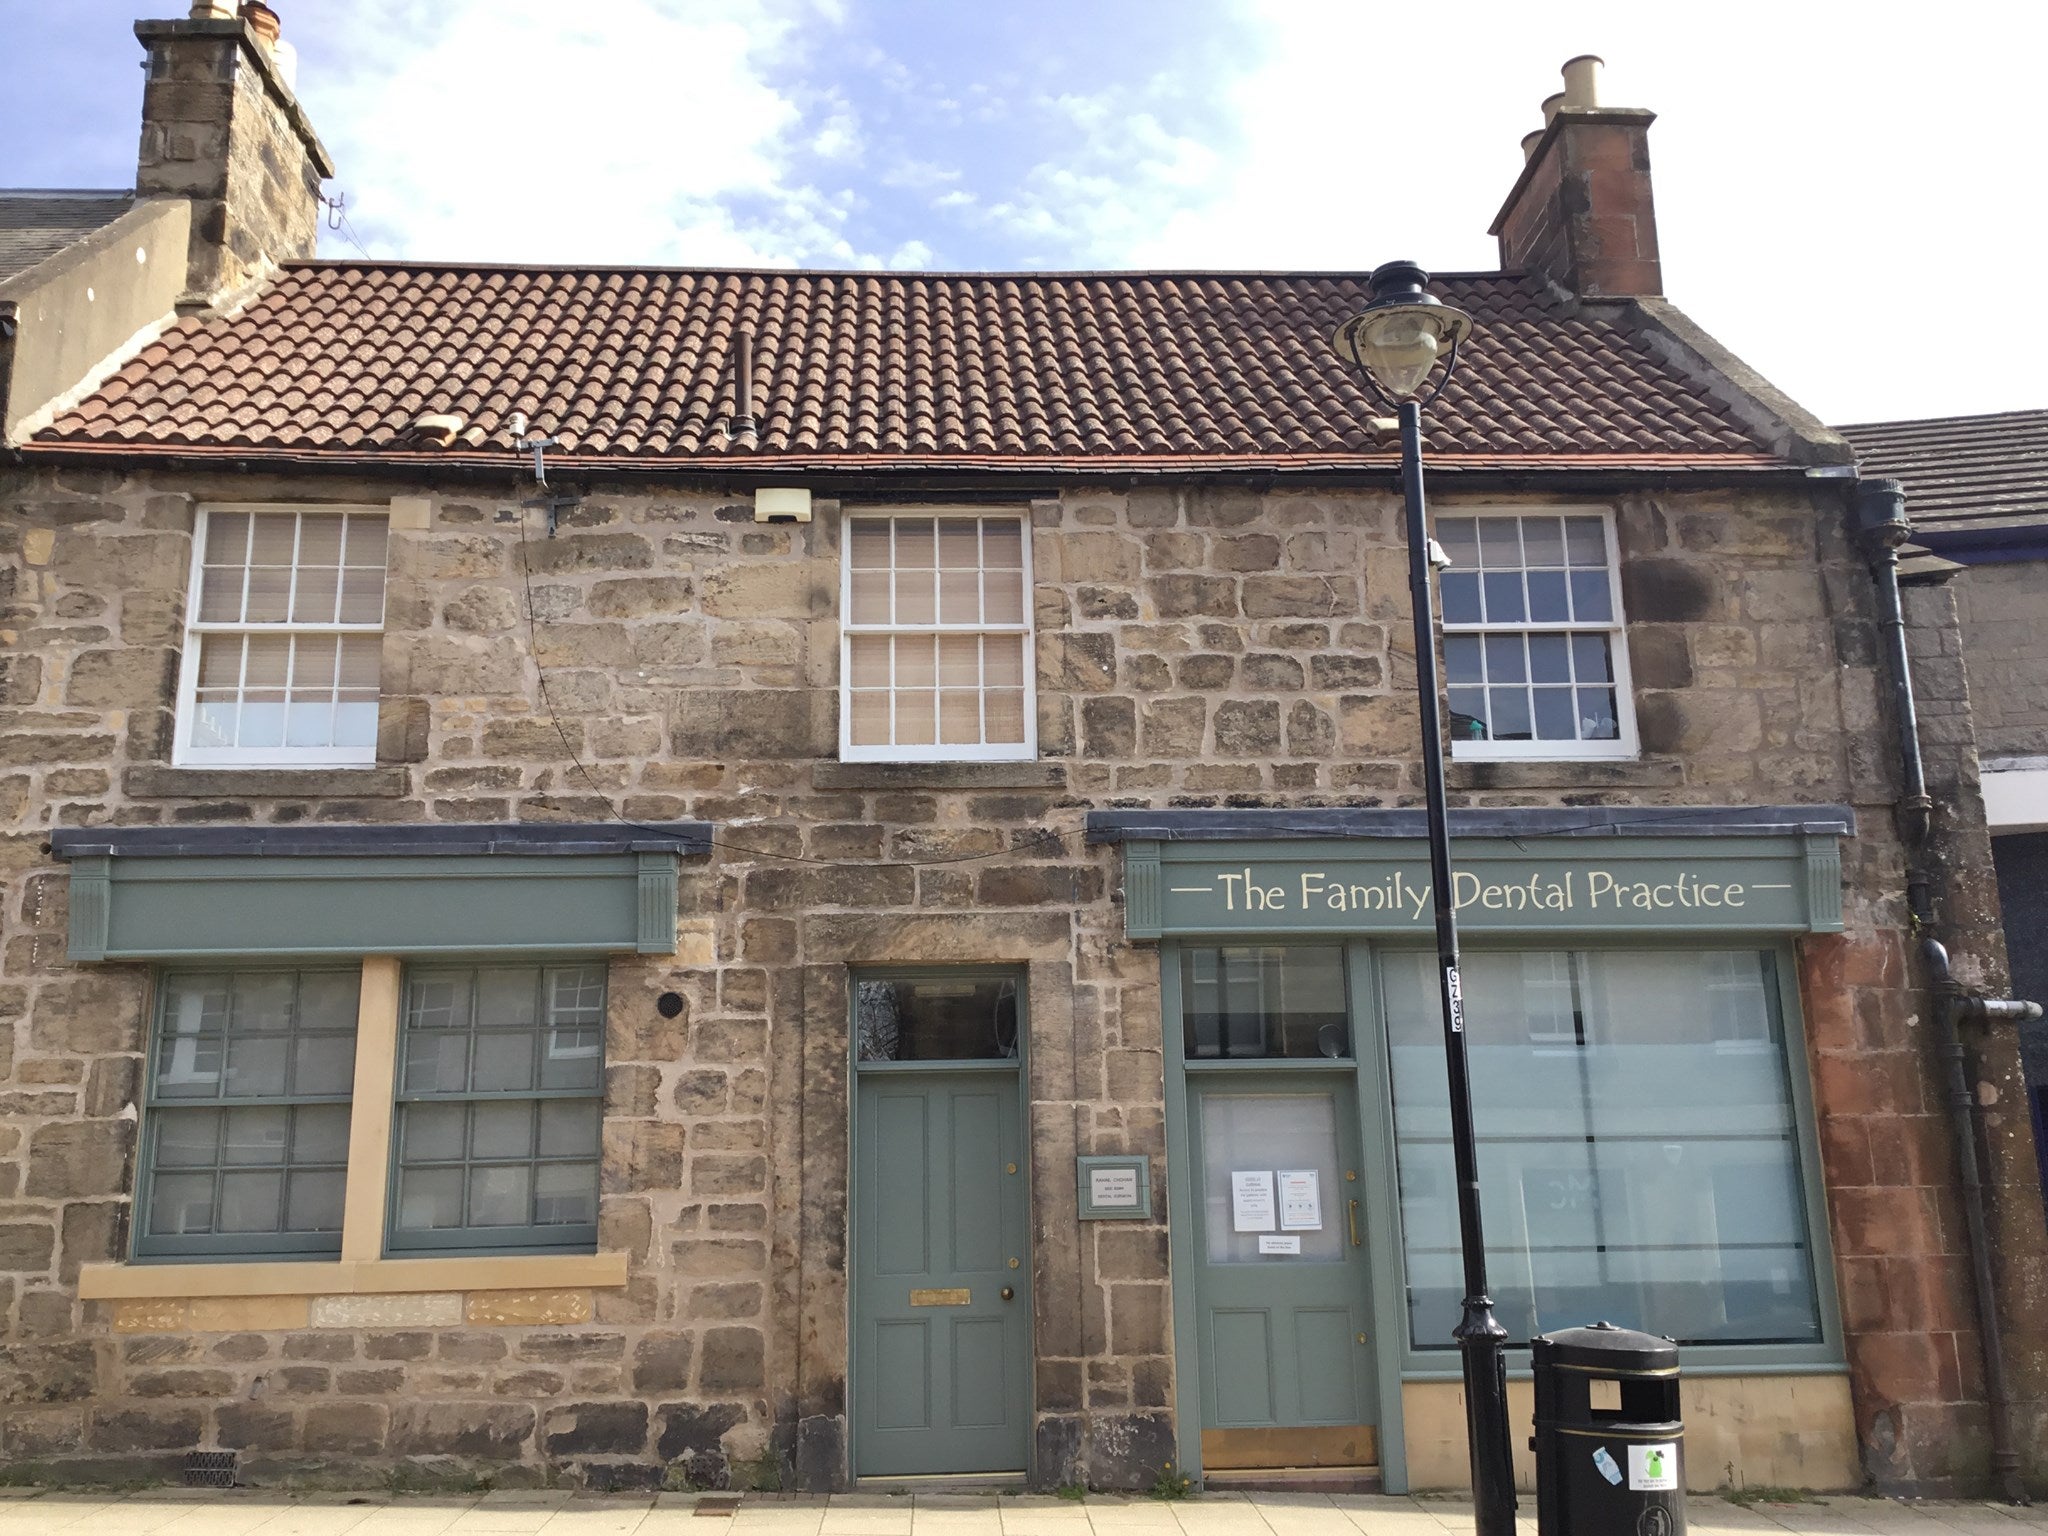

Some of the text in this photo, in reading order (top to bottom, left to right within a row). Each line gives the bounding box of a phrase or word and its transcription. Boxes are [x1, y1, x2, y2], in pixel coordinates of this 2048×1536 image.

[1217, 868, 1745, 920] The Family Dental Practice
